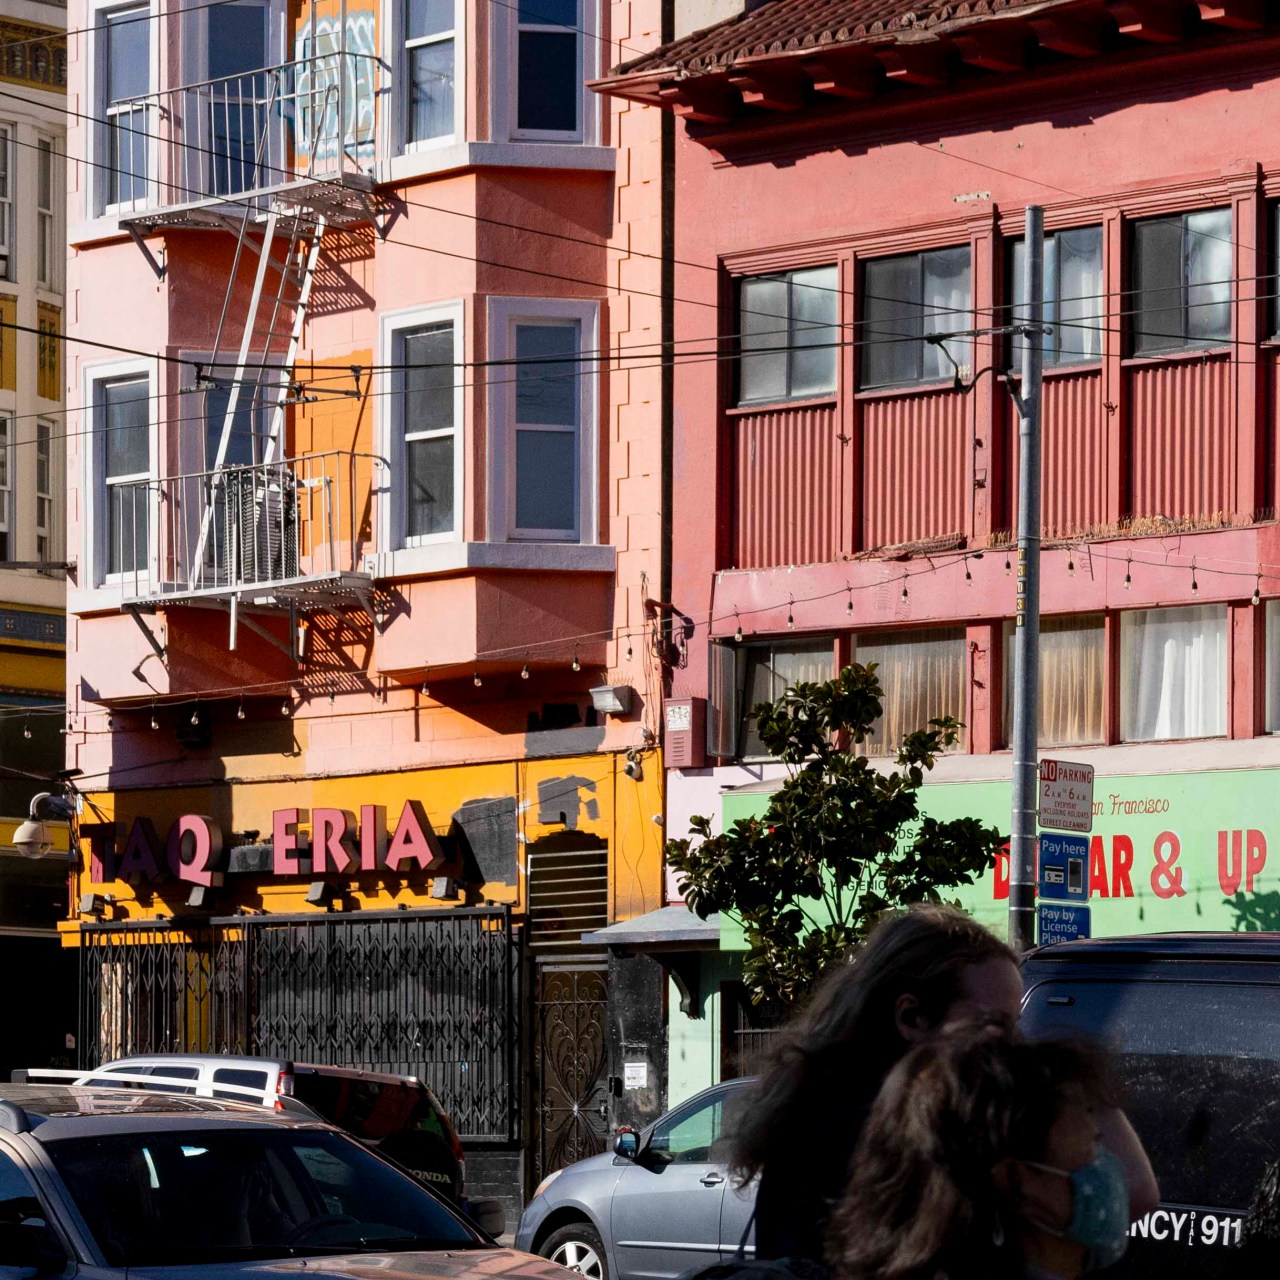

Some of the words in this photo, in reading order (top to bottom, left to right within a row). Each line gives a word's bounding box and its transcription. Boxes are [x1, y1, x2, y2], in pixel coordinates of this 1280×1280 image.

[1041, 761, 1056, 780] NO
[1058, 767, 1092, 784] PARKING
[1044, 784, 1051, 797] 2
[1068, 787, 1075, 800] 6
[1109, 794, 1170, 816] Francisco
[1042, 807, 1067, 818] INCLUDING
[1068, 811, 1090, 820] HOLIDAYS
[1043, 818, 1061, 827] STREET
[1063, 820, 1088, 830] CLEANING
[1043, 840, 1061, 855] Pay
[1062, 841, 1086, 855] here
[1149, 830, 1188, 899] &
[1217, 829, 1267, 897] UP
[1042, 908, 1060, 920] Pay
[1063, 909, 1075, 924] by
[1042, 921, 1078, 933] License
[1042, 932, 1067, 944] Plate
[411, 1169, 452, 1184] ONDA
[1200, 1214, 1242, 1246] 911
